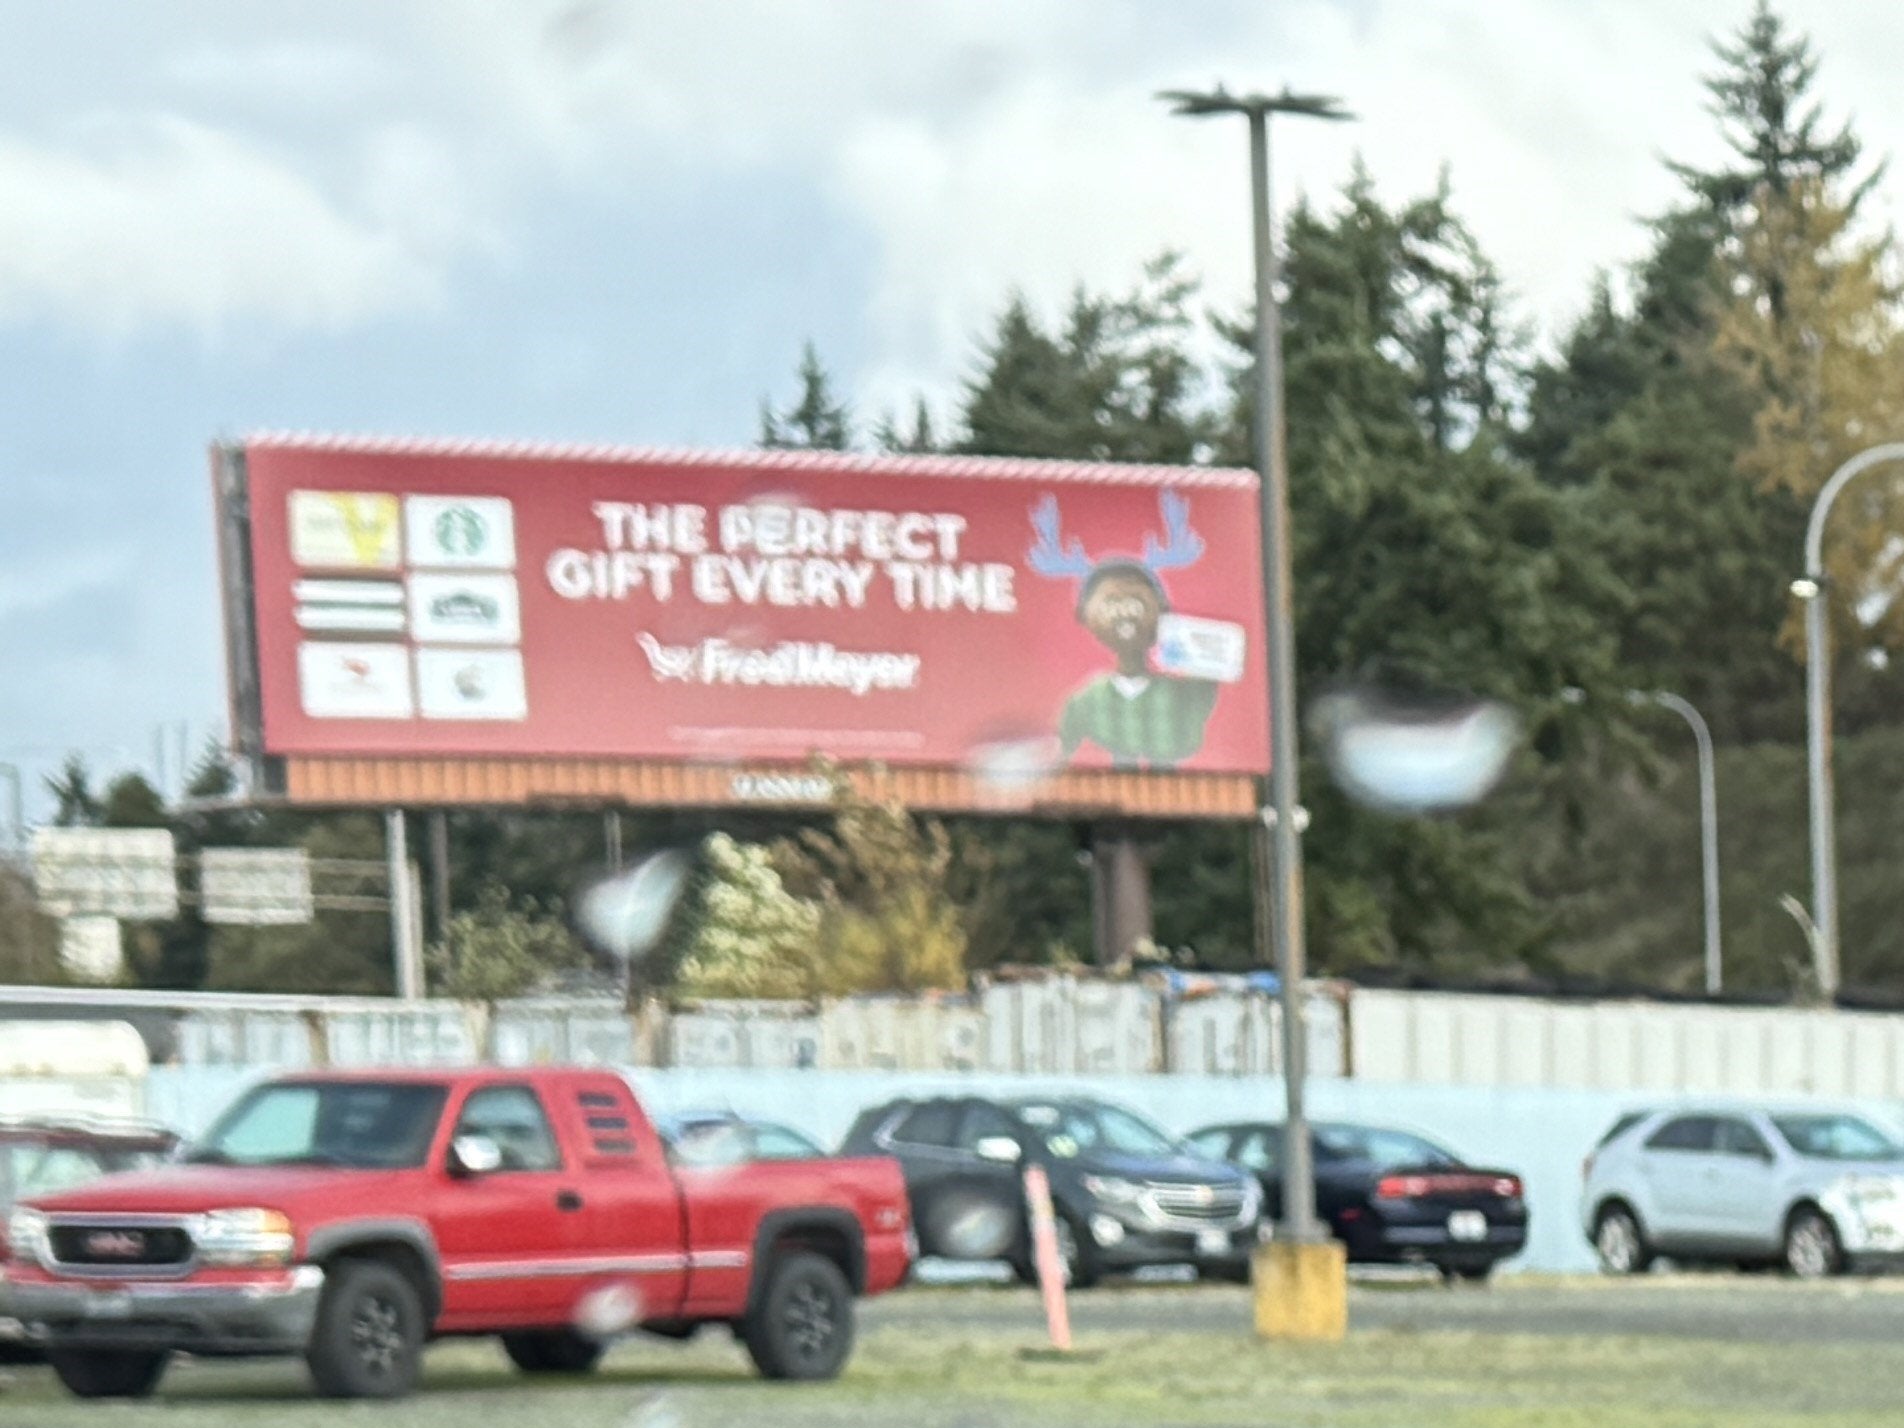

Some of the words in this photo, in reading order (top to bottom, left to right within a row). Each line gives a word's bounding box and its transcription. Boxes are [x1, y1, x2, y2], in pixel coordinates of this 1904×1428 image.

[592, 501, 708, 554] THE
[719, 503, 967, 561] PERFECT
[546, 548, 680, 602] GIFT
[692, 553, 874, 608] EVERY
[886, 562, 1018, 613] TIME
